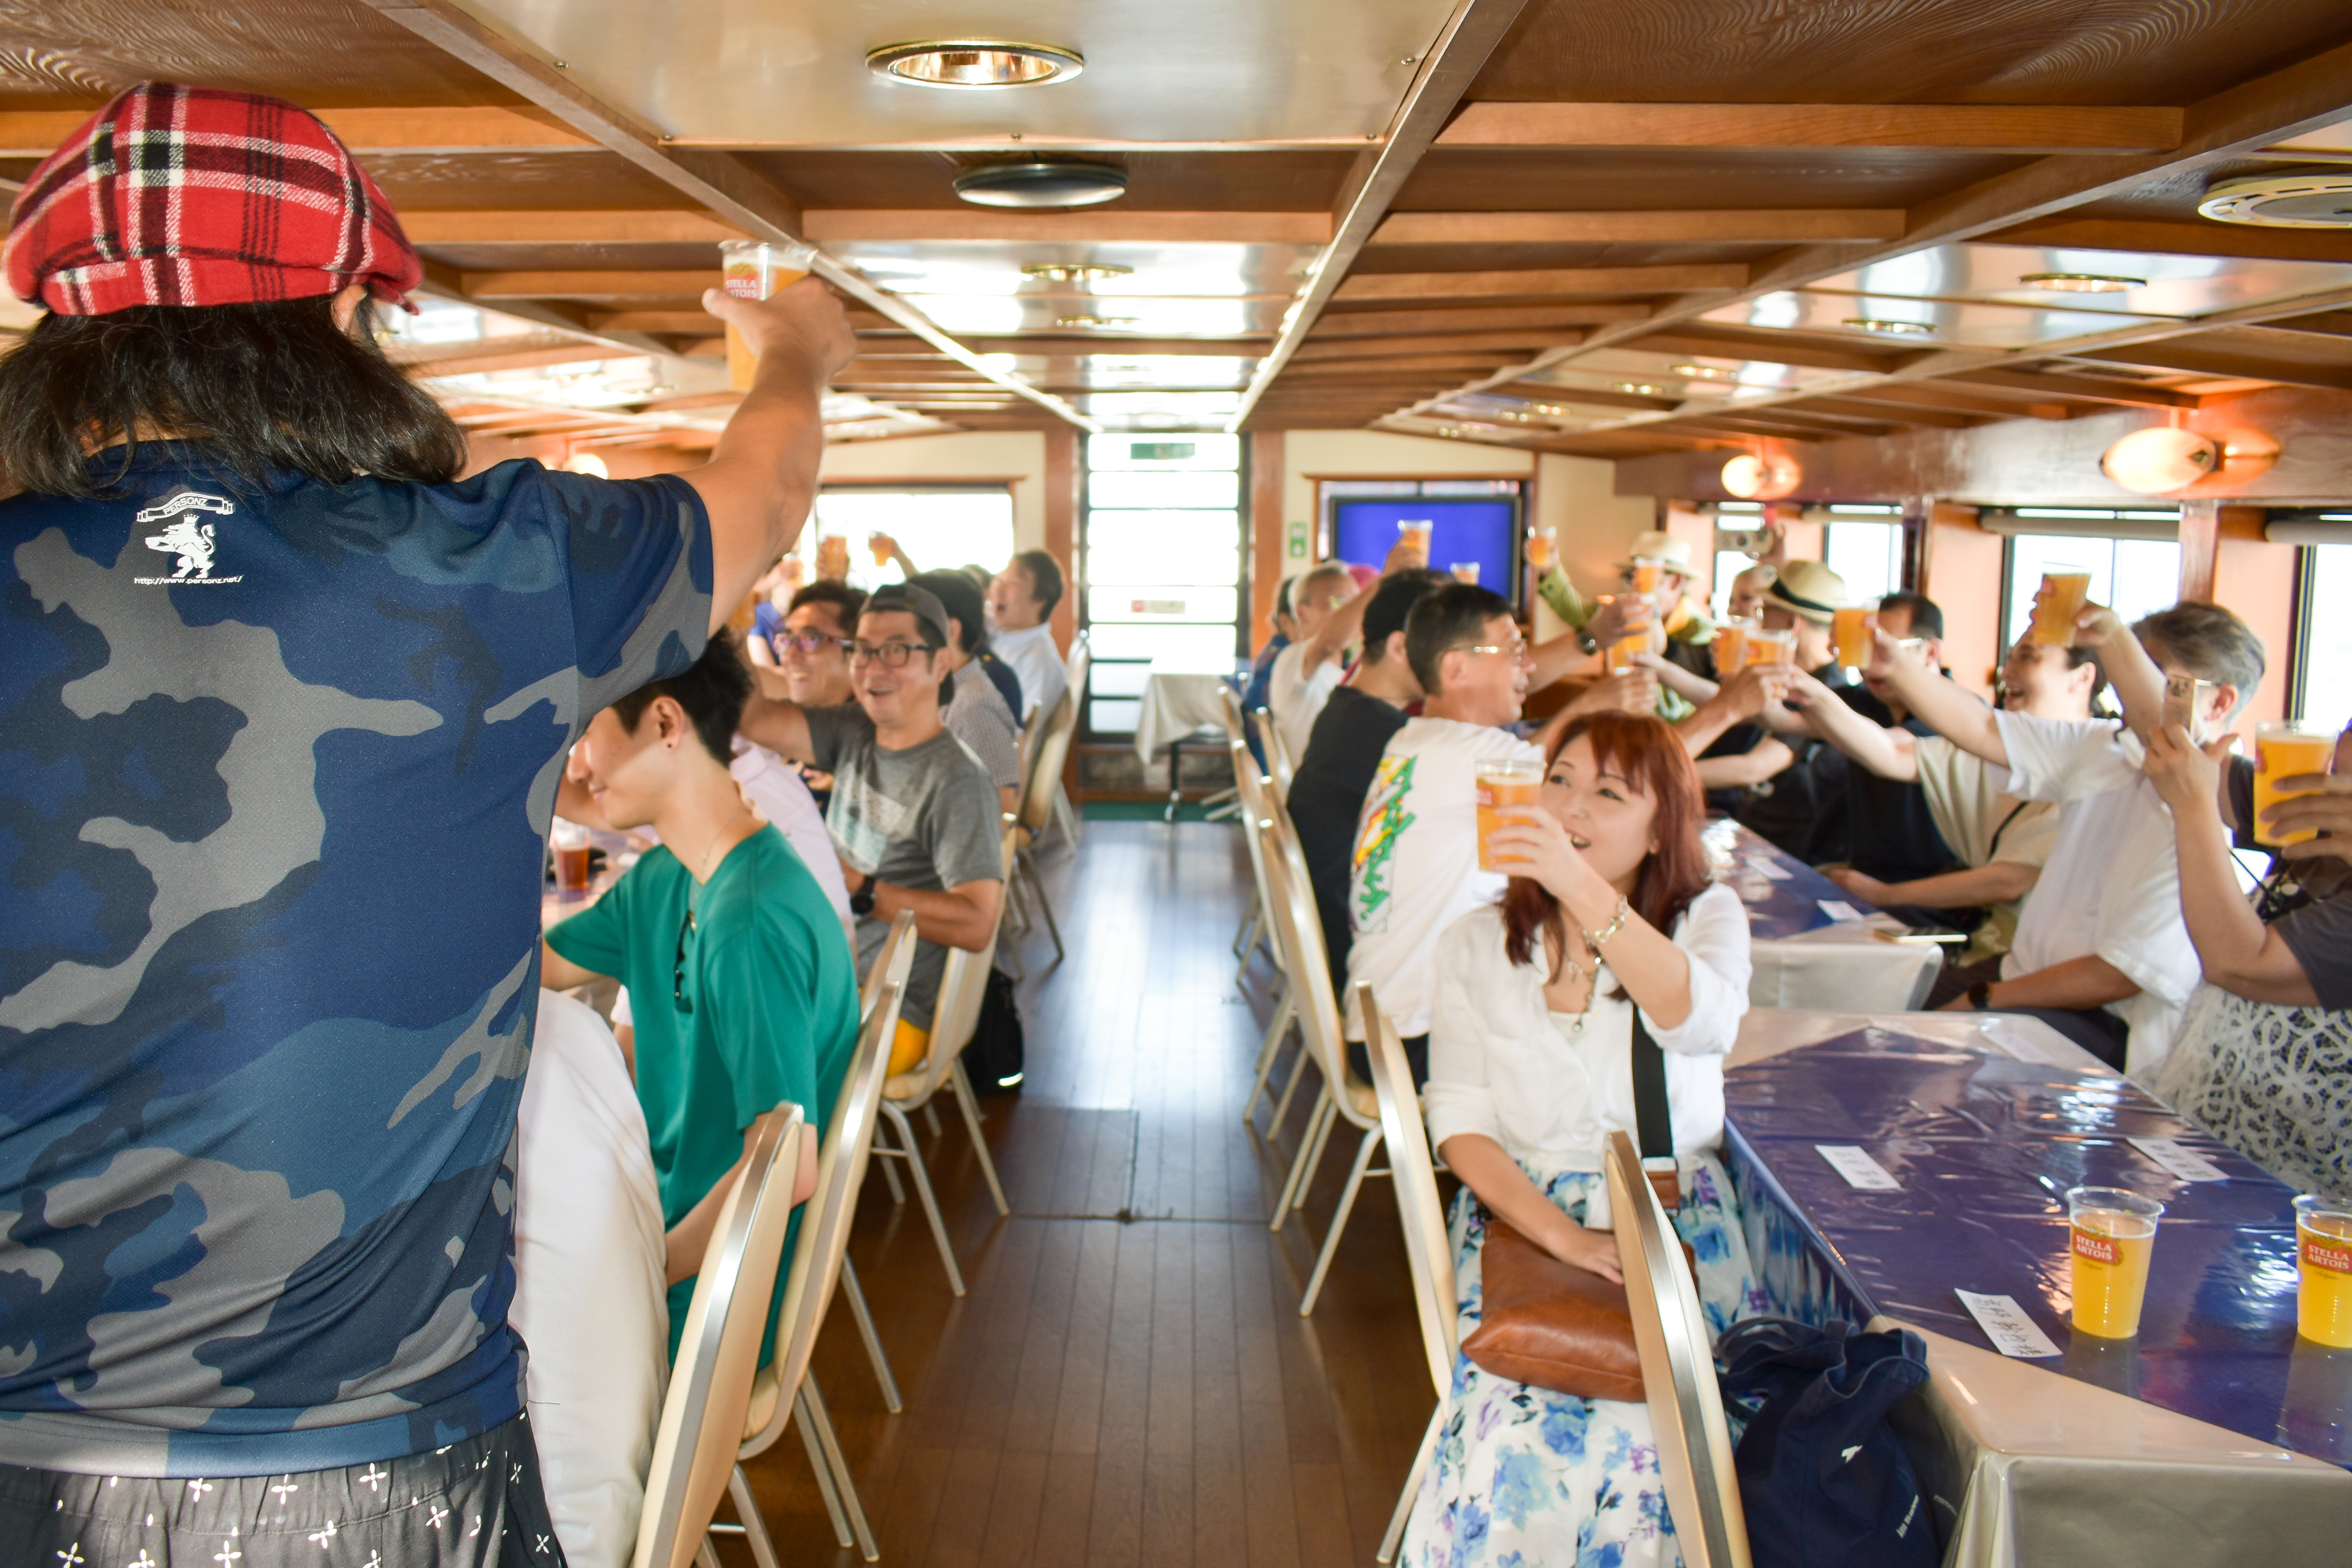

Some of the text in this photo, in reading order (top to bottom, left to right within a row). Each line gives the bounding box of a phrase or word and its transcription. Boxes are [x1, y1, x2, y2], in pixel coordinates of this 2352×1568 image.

[727, 289, 757, 298] RTOIS
[162, 497, 208, 515] PERSONZ
[134, 575, 243, 585] http://www.personz.net/
[2076, 1234, 2112, 1252] STELLA
[2076, 1244, 2112, 1260] ARTOIS
[2308, 1245, 2349, 1261] STELLA
[2308, 1253, 2349, 1269] ARTOIS
